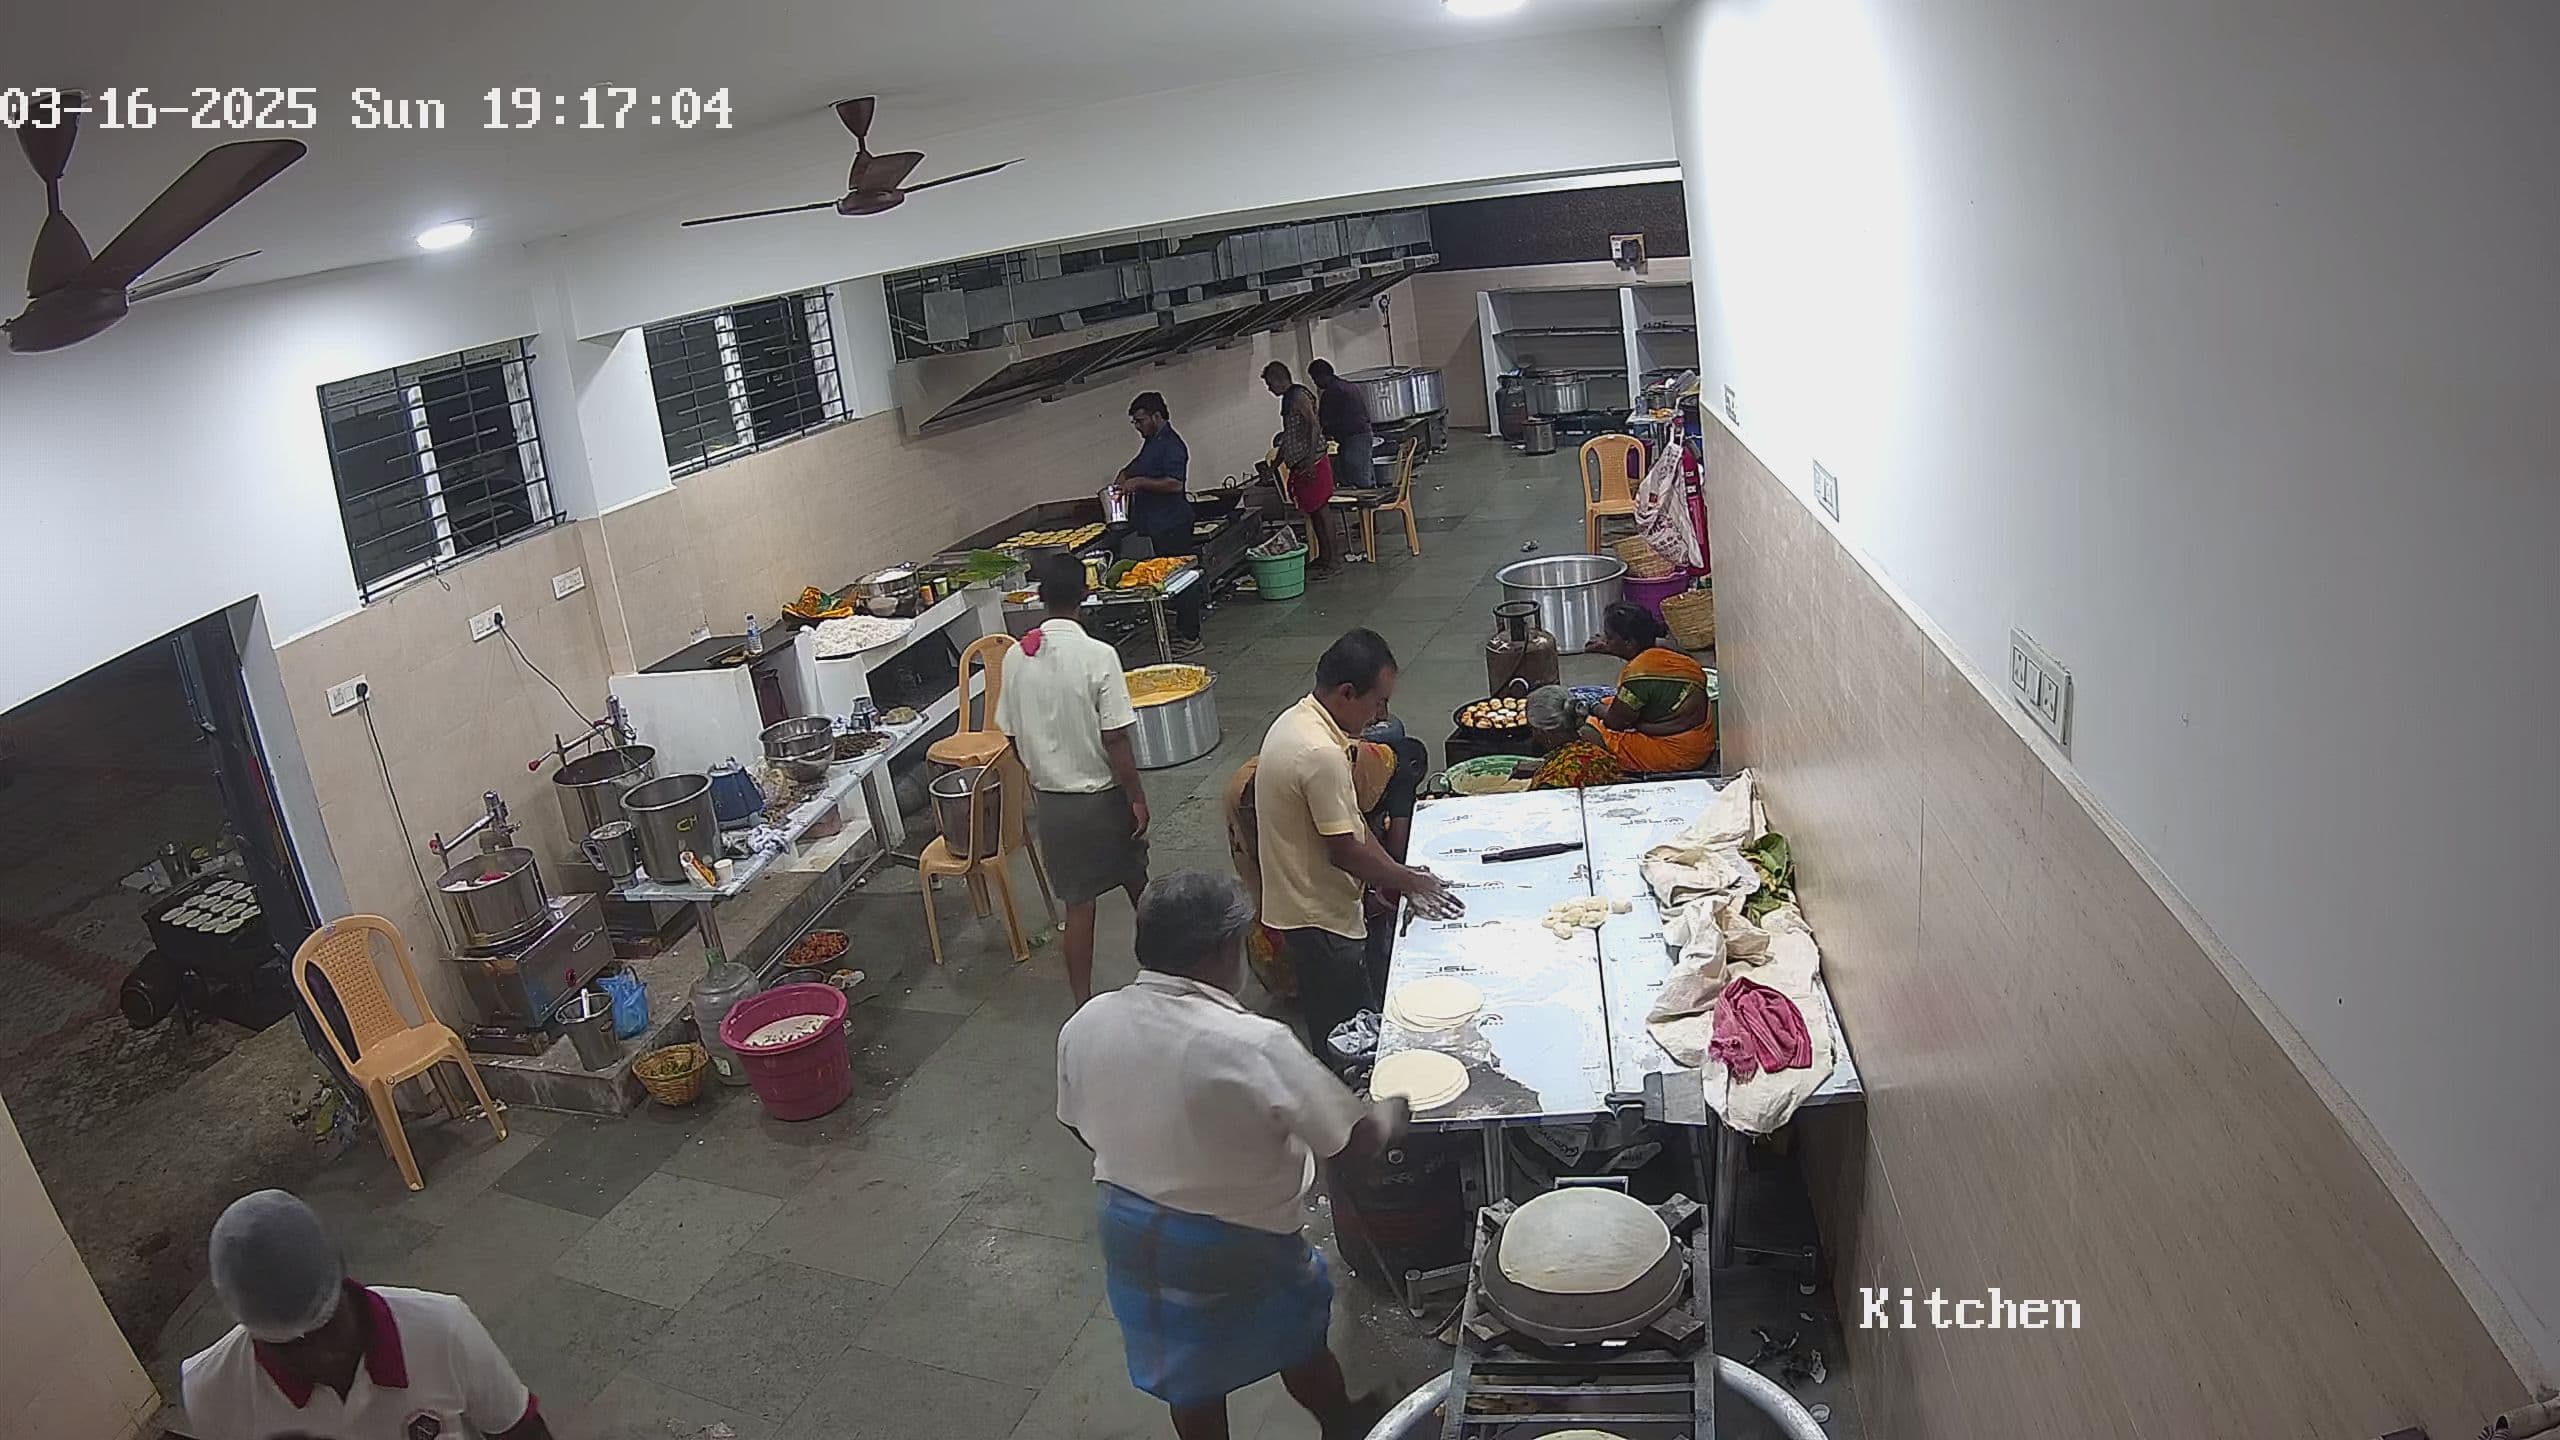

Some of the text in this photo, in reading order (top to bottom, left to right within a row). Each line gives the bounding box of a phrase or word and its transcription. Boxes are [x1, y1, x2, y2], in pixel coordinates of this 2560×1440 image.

[1438, 848, 1482, 856] JSL
[1430, 922, 1481, 931] JSL
[1425, 965, 1478, 974] JSL
